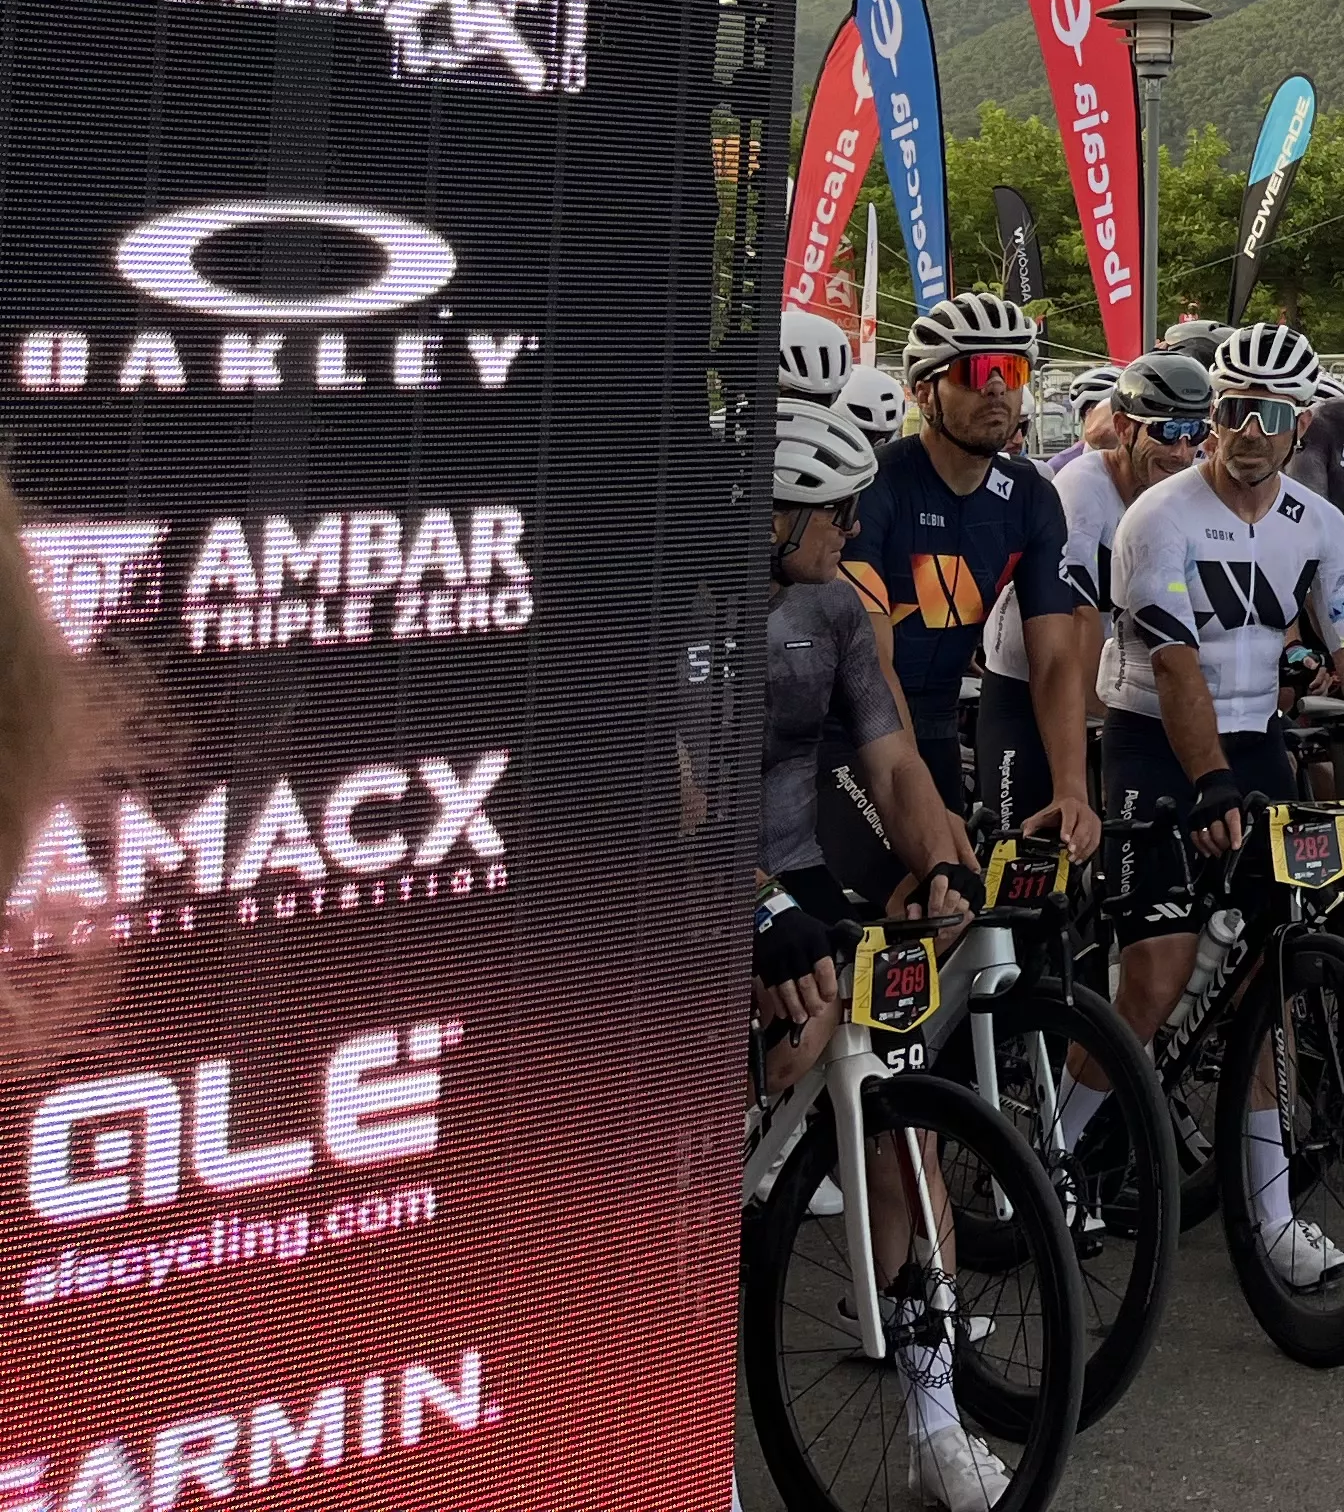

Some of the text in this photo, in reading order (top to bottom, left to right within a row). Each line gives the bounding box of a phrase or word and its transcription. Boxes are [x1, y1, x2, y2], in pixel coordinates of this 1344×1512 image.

[1243, 94, 1310, 260] POWERADE
[20, 330, 526, 392] OAKLEY
[920, 512, 945, 528] GOBIK
[1205, 528, 1235, 542] GOBIK
[184, 503, 531, 600] AMBAR
[182, 598, 374, 654] TRIPLE
[391, 589, 534, 641] ZERO
[832, 764, 867, 810] Alejandro
[14, 750, 512, 916] AMACX
[1293, 834, 1330, 862] 282
[1008, 875, 1047, 899] 311
[885, 963, 924, 998] 269
[886, 1042, 924, 1073] 50
[20, 1183, 440, 1306] alecycling.com
